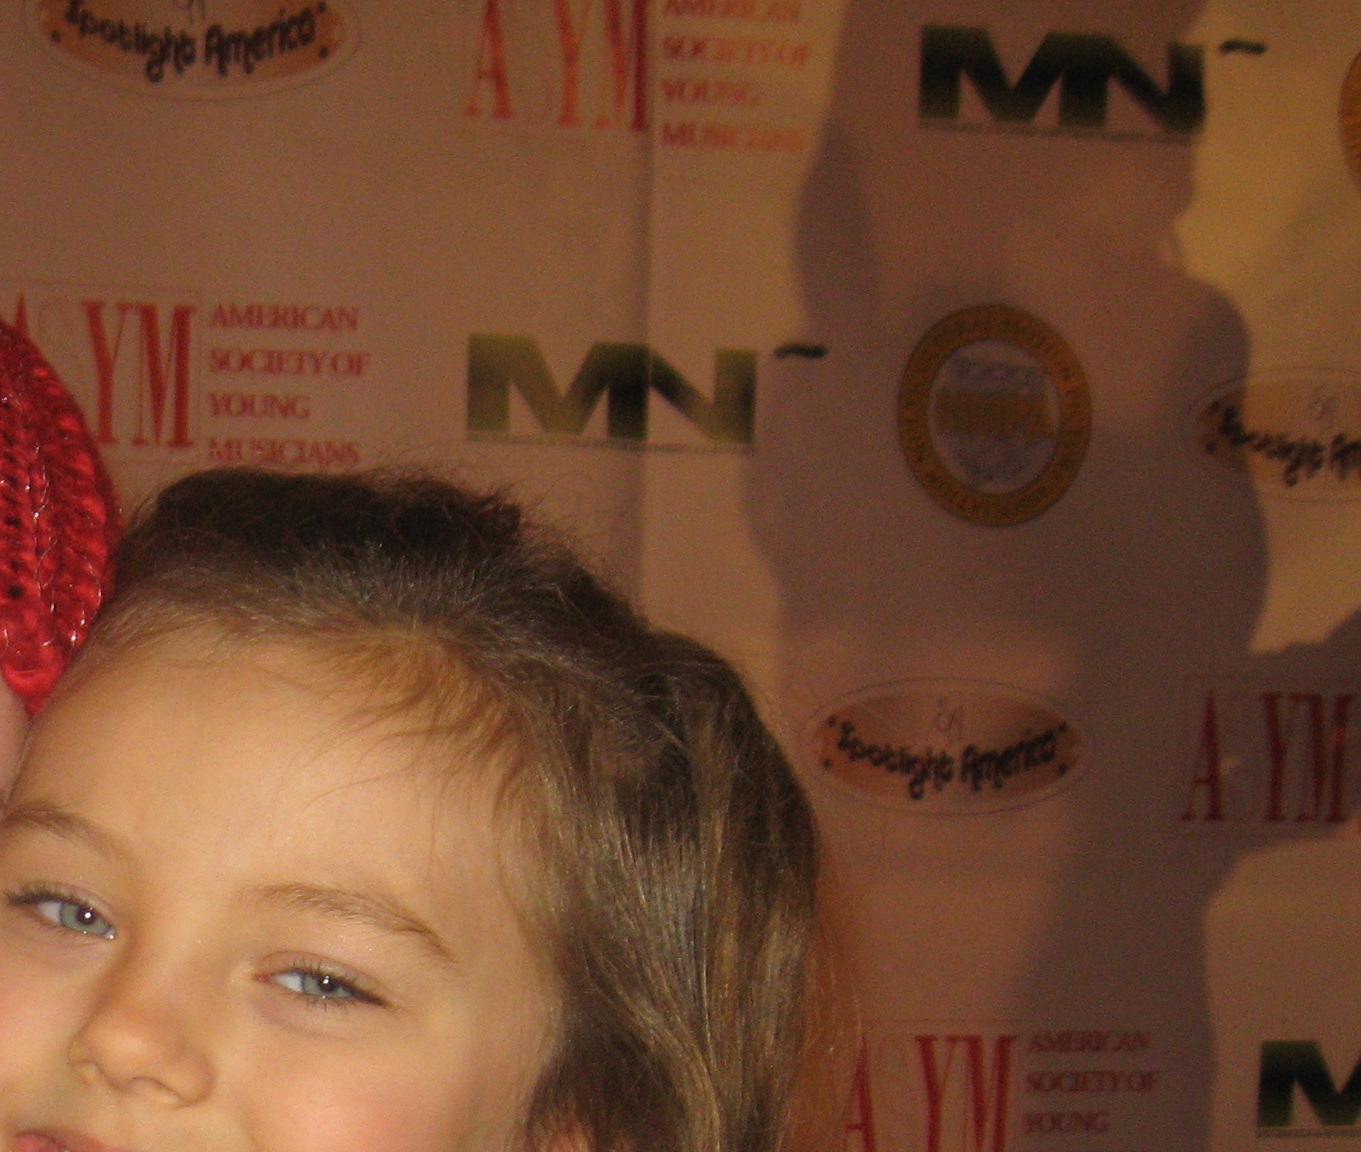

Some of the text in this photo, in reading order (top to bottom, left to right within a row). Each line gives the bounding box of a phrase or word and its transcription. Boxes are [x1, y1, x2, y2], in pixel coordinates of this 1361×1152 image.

[209, 302, 360, 333] AMERICAN
[208, 348, 372, 378] SOCIETY OF
[208, 392, 311, 421] YOUNG
[1028, 1030, 1151, 1054] AMERICAN
[1026, 1070, 1159, 1095] SOCIETY OF
[1022, 1110, 1110, 1134] YOUNG
